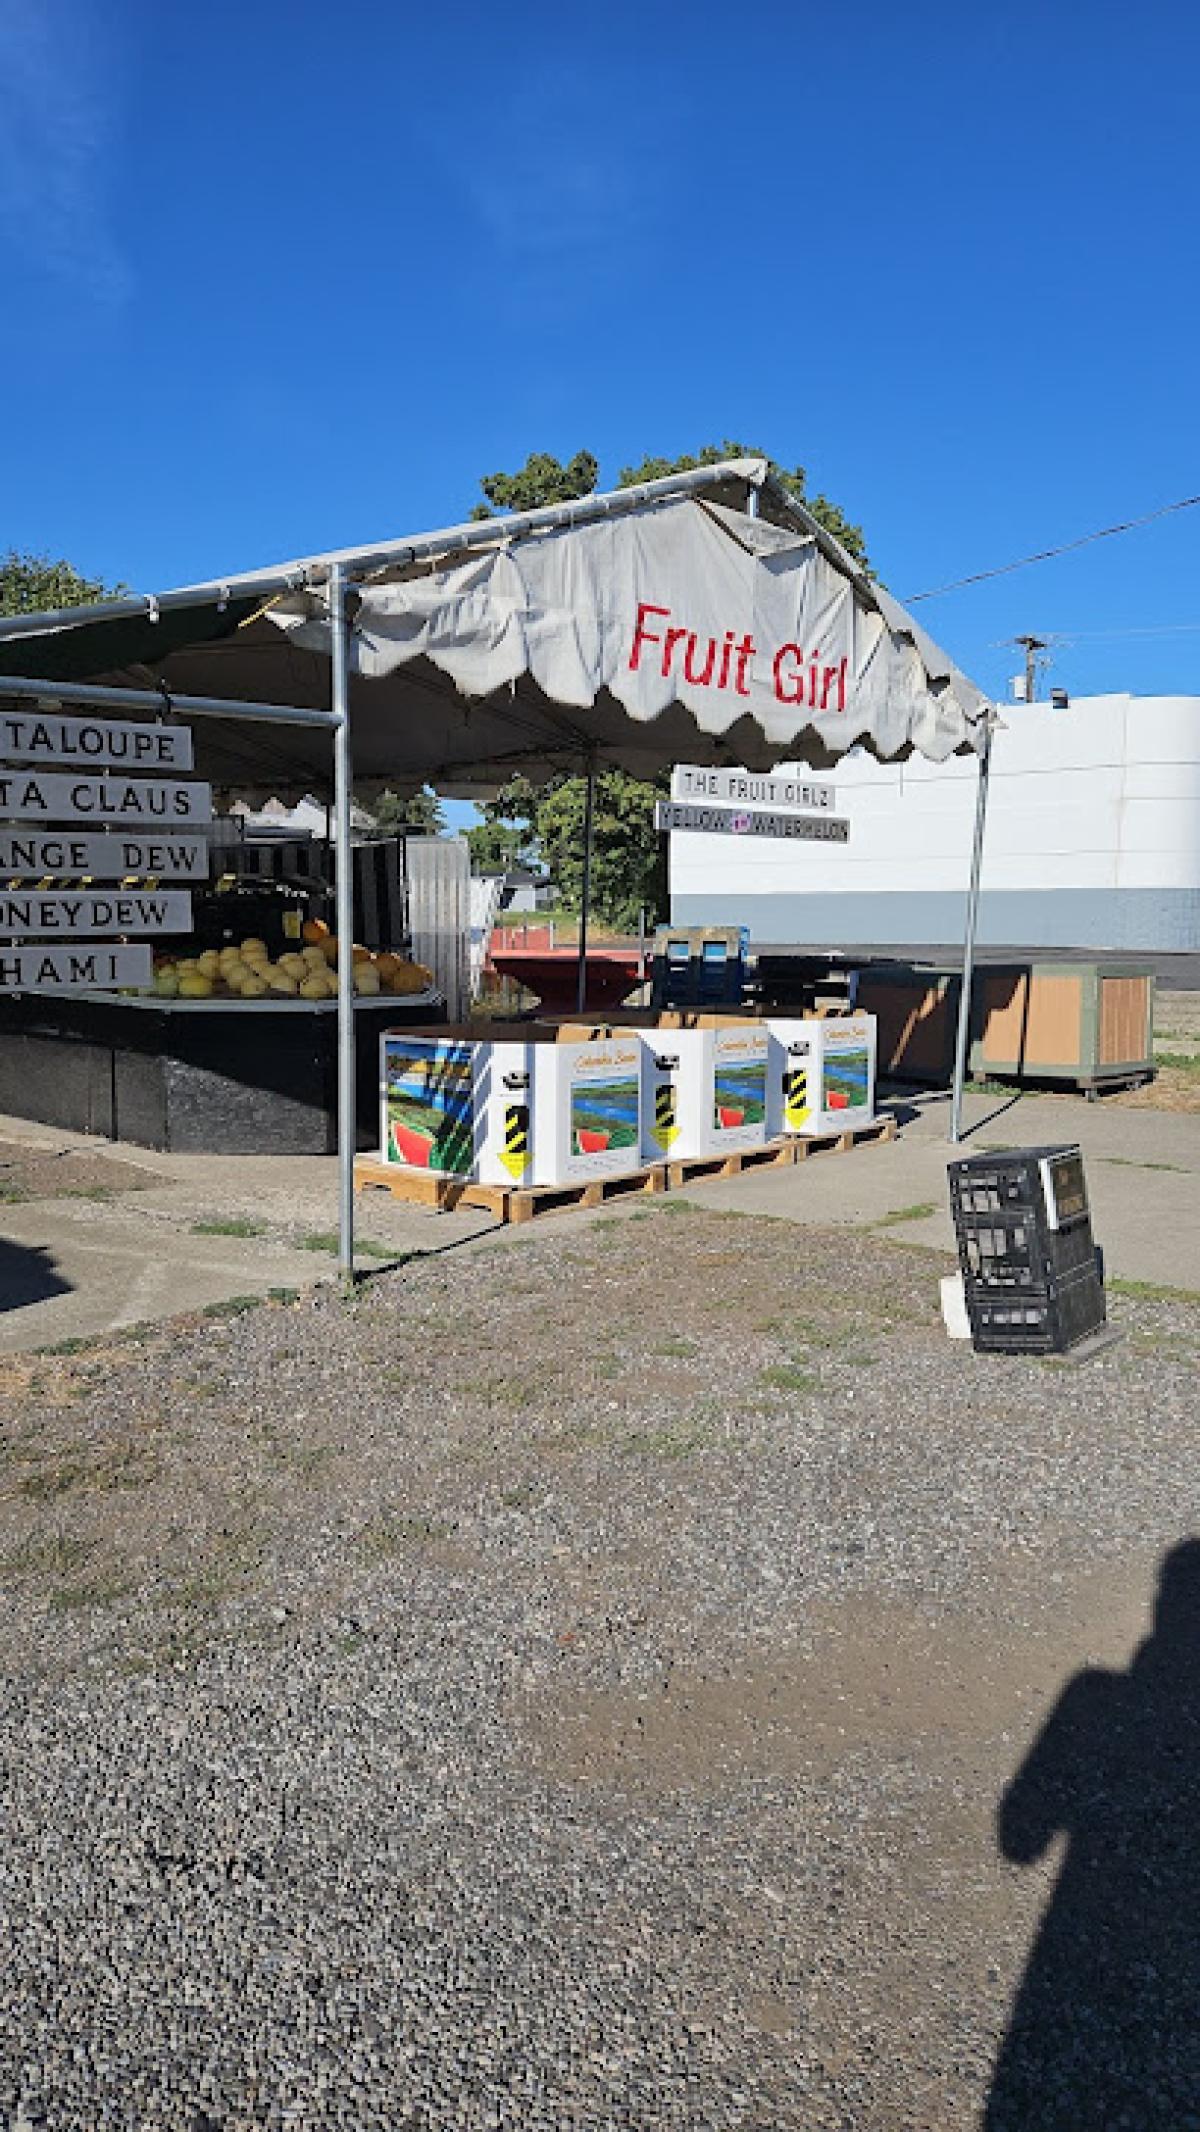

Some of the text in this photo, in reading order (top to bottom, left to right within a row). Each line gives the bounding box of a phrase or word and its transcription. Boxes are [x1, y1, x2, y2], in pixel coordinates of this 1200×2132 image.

[628, 602, 848, 713] Fruit Girl
[5, 719, 175, 762] TALOUPE
[70, 784, 191, 816] CLAUS
[684, 772, 719, 795] THE
[728, 778, 777, 801] FRUIT
[0, 840, 199, 872] NGE DEW
[0, 901, 169, 927] NEYDEW
[0, 954, 118, 985] HAMI
